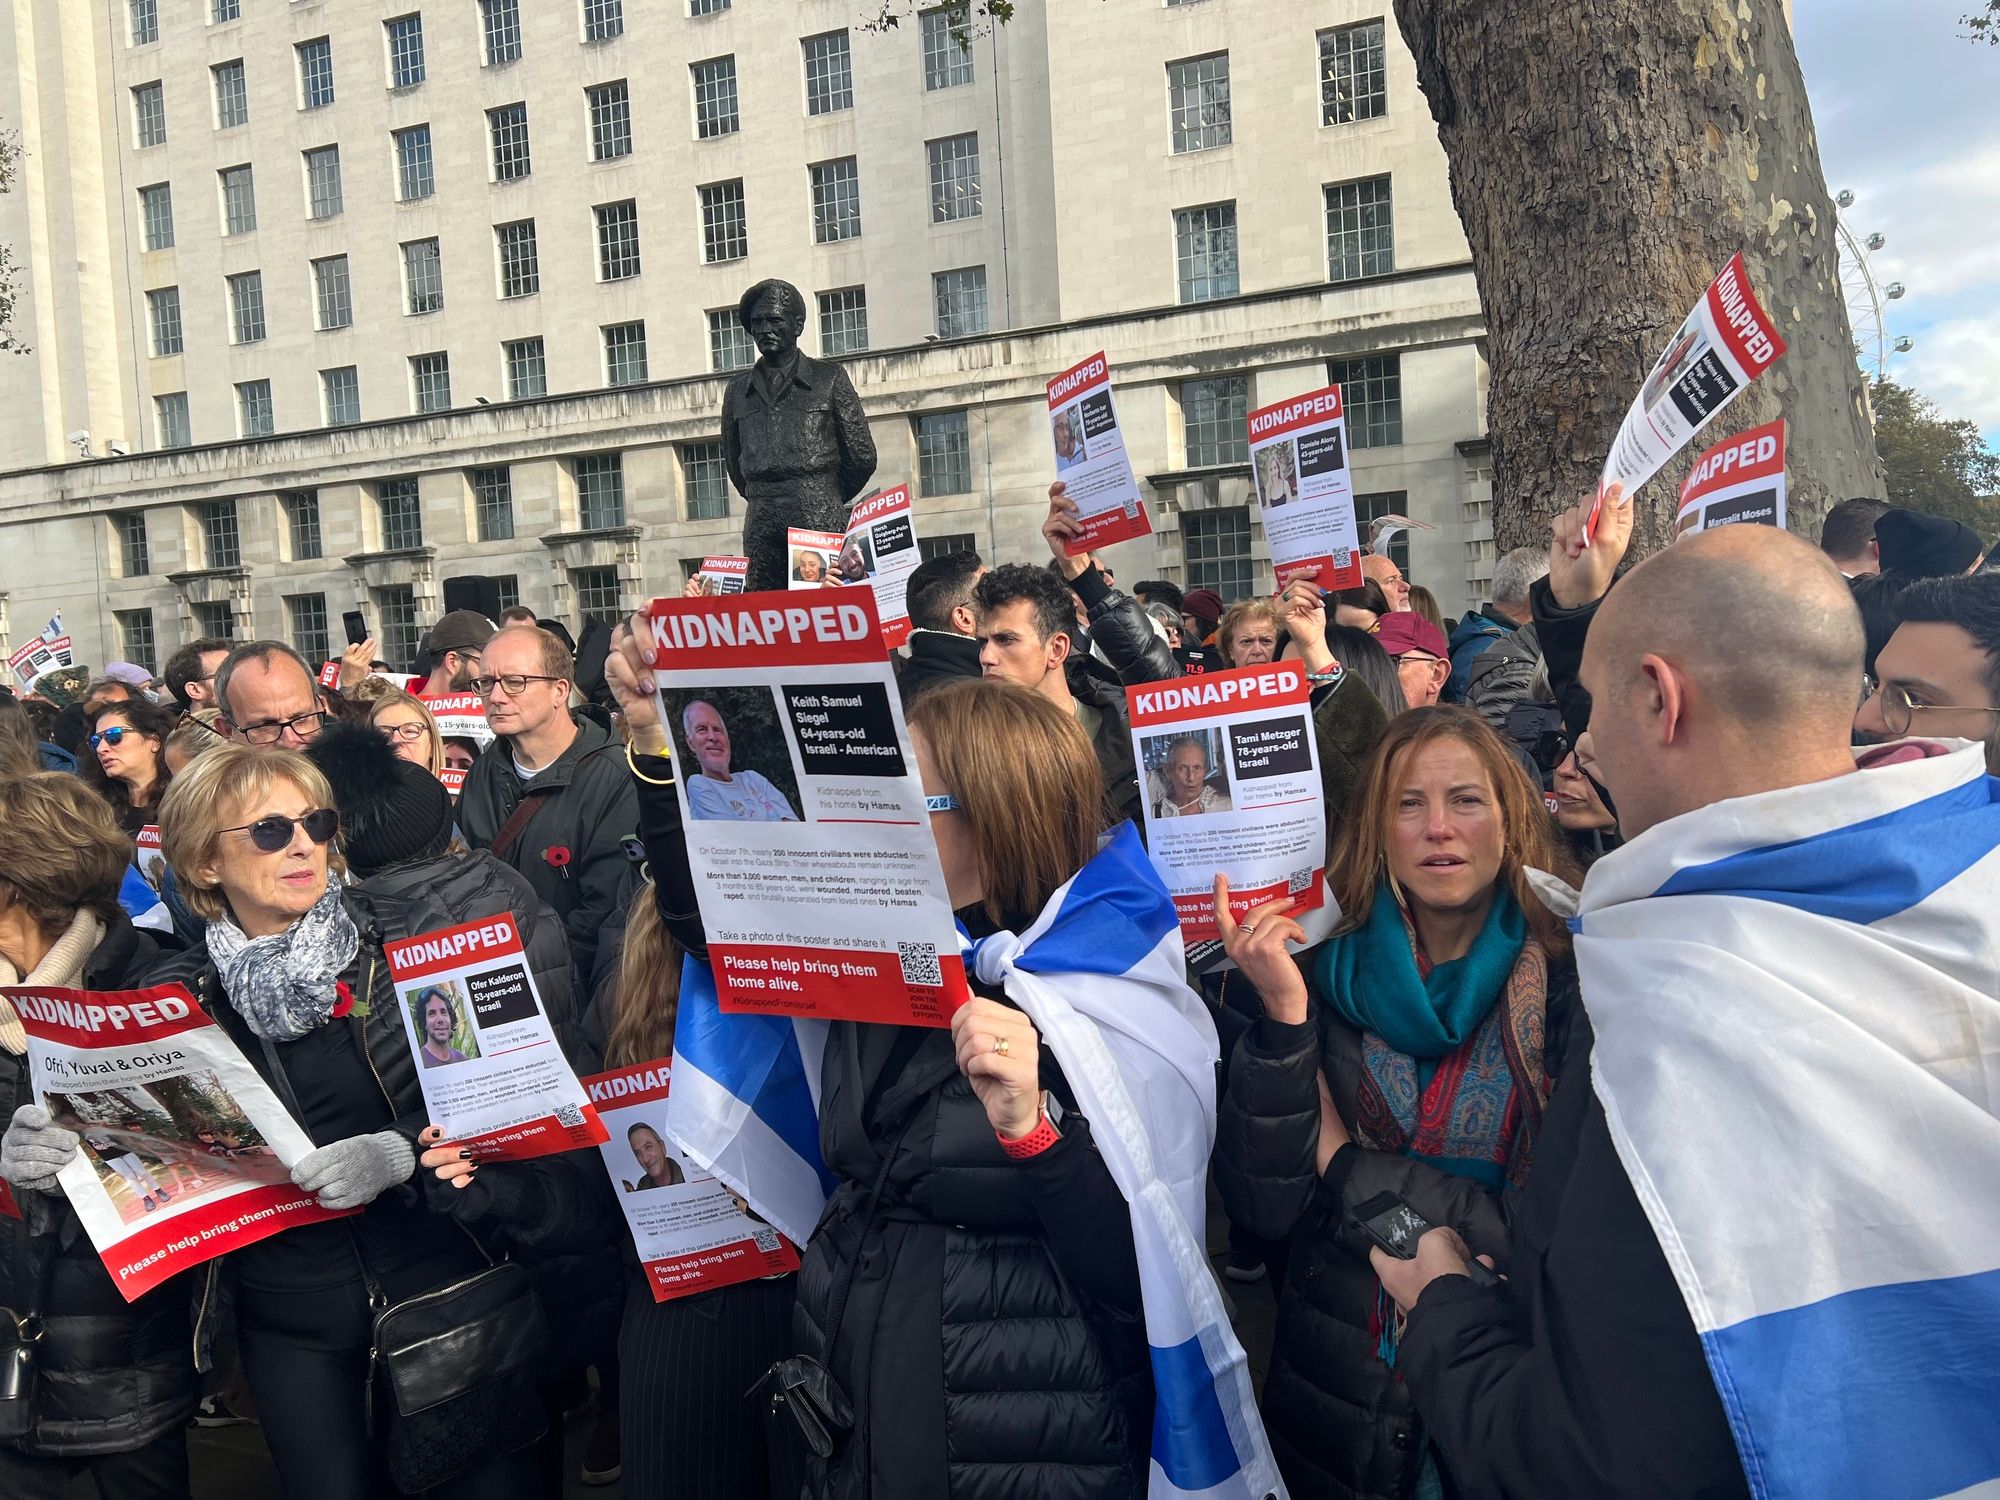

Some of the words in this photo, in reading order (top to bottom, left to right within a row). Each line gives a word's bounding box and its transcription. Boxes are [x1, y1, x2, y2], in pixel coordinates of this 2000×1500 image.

[1717, 266, 1774, 365] KIDNAPPED
[1049, 358, 1104, 402] KIDNAPPED
[1250, 393, 1337, 435] KIDNAPPED
[1688, 436, 1777, 490] NAPPED
[851, 491, 905, 523] NAPPED
[1741, 507, 1773, 521] Moses
[792, 533, 844, 547] KIDNAPP
[703, 559, 748, 570] KIDNAPPED
[651, 604, 869, 649] KIDNAPPED
[889, 623, 904, 631] them
[10, 640, 41, 666] KIDNAPPED
[1135, 671, 1299, 715] KIDNAPPED
[422, 697, 483, 711] KIDNAPP
[791, 696, 821, 708] Keith
[821, 695, 862, 707] Samuel
[796, 712, 829, 726] Siegel
[800, 728, 866, 741] 64-years-old
[1235, 733, 1259, 744] Tami
[1260, 729, 1301, 741] Metzger
[804, 744, 838, 755] Israeli
[846, 744, 898, 756] American
[1236, 740, 1299, 757] 78-years-old
[1239, 757, 1270, 768] Israeli
[817, 787, 862, 797] Kidnapped
[862, 788, 882, 797] from
[1243, 783, 1277, 793] Kidnapped
[1256, 792, 1274, 800] home
[1284, 788, 1307, 796] Hamas
[820, 800, 833, 809] his
[834, 801, 857, 809] home
[858, 801, 869, 811] by
[772, 849, 786, 857] 200
[787, 849, 819, 858] innocent
[820, 850, 852, 858] civilians
[873, 851, 909, 859] abducted
[909, 852, 926, 860] from
[706, 872, 725, 880] More
[726, 872, 741, 880] than
[742, 873, 761, 881] 3,000
[762, 874, 790, 882] women,
[791, 875, 809, 883] men,
[859, 877, 888, 886] ranging
[897, 878, 912, 886] age
[912, 878, 930, 886] from
[1246, 881, 1260, 889] and
[1260, 878, 1279, 887] share
[817, 887, 853, 895] wounded,
[854, 888, 894, 896] murdered,
[894, 888, 924, 897] beaten,
[1185, 886, 1204, 895] photo
[878, 898, 889, 907] by
[890, 899, 920, 907] Hamas.
[1174, 902, 1199, 913] lease
[1200, 901, 1215, 912] hel
[1228, 900, 1249, 911] ring
[1250, 893, 1274, 906] them
[1198, 914, 1215, 923] aliv
[392, 922, 513, 970] KIDNAPPED
[718, 931, 739, 941] Take
[741, 933, 748, 942] a
[749, 932, 774, 944] photo
[775, 932, 785, 943] of
[786, 932, 802, 944] this
[803, 934, 831, 947] poster
[833, 936, 851, 947] and
[852, 937, 878, 948] share
[879, 938, 887, 949] it
[723, 956, 769, 971] Please
[771, 957, 800, 974] help
[803, 959, 840, 977] bring
[841, 962, 878, 977] them
[470, 980, 488, 991] Ofer
[488, 971, 525, 987] Kalderon
[728, 975, 766, 989] home
[769, 976, 803, 992] alive.
[474, 983, 522, 1002] 53-years-old
[910, 994, 925, 1002] JOIN
[926, 996, 938, 1004] THE
[10, 996, 191, 1032] KIDNAPPED
[477, 1000, 502, 1014] Israeli
[911, 1002, 939, 1012] GLOBAL
[912, 1011, 944, 1020] EFFORTS
[487, 1030, 514, 1040] Kidnapped
[519, 1032, 539, 1041] Hamas
[45, 1057, 69, 1078] Ofri,
[68, 1060, 116, 1076] Yuval
[116, 1059, 132, 1071] &
[132, 1050, 186, 1068] Oriya
[50, 1080, 82, 1089] Kidnapped
[82, 1080, 101, 1089] from
[102, 1078, 120, 1086] their
[121, 1075, 143, 1083] home
[155, 1064, 185, 1077] Hamas
[588, 1066, 672, 1102] KIDNAP
[457, 1131, 475, 1140] photo
[493, 1120, 511, 1130] poster
[512, 1116, 525, 1124] and
[524, 1112, 542, 1121] share
[478, 1140, 497, 1148] help
[497, 1133, 522, 1144] bring
[522, 1126, 546, 1137] them
[119, 1249, 167, 1280] Please
[167, 1234, 200, 1255] help
[200, 1220, 240, 1241] bring
[238, 1208, 276, 1226] them
[275, 1198, 314, 1213] home
[664, 1249, 681, 1258] photo
[697, 1242, 714, 1251] poster
[725, 1235, 742, 1243] share
[654, 1263, 680, 1275] Please
[680, 1259, 699, 1270] help
[699, 1255, 723, 1266] bring
[722, 1249, 745, 1260] them
[658, 1274, 681, 1285] home
[681, 1270, 704, 1280] alive.
